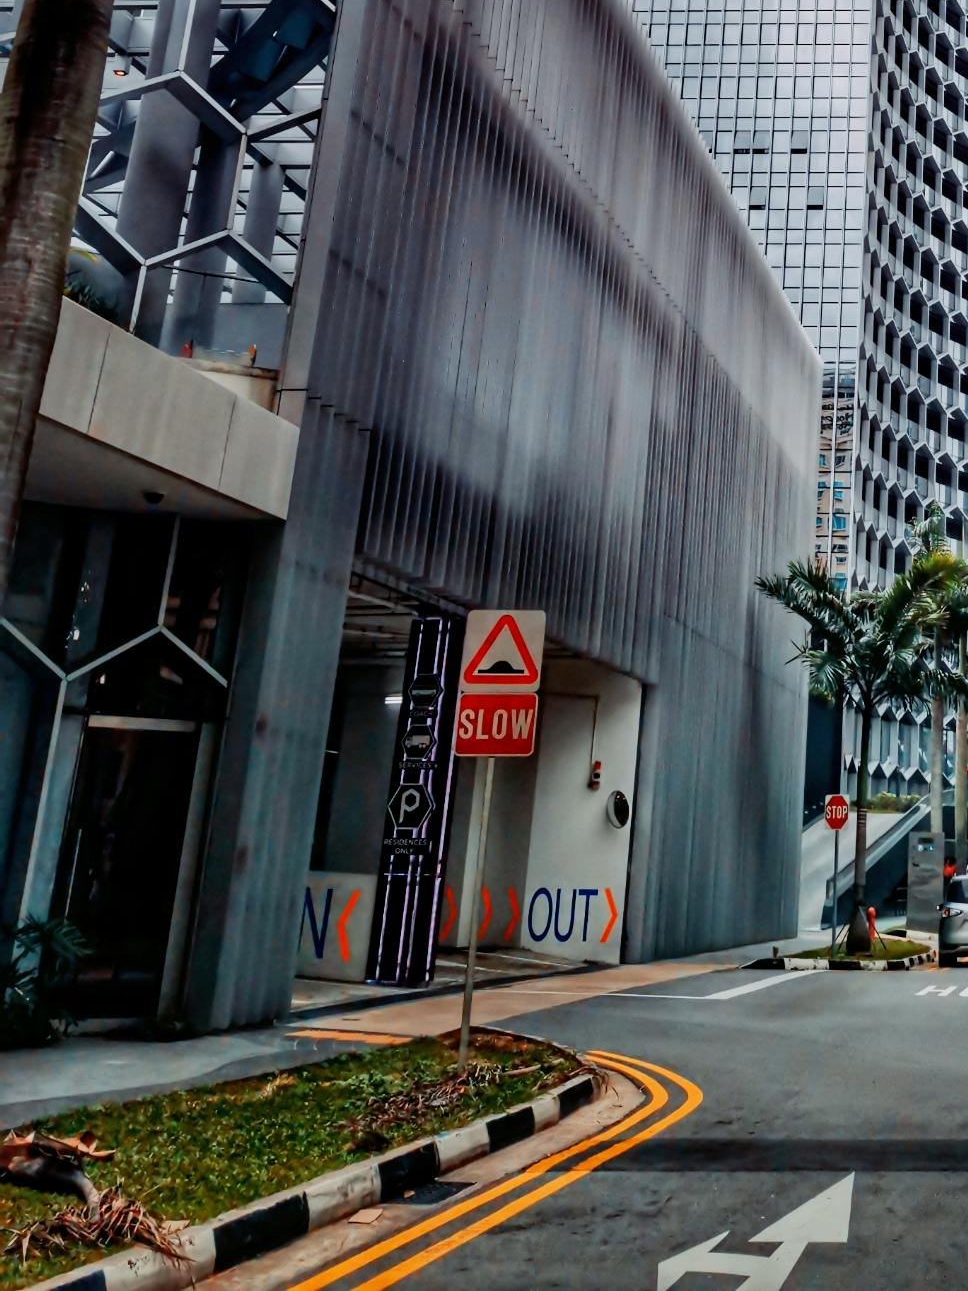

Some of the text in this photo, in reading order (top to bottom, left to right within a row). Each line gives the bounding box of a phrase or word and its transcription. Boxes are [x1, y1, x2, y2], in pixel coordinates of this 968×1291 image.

[459, 709, 534, 741] SLOW
[398, 761, 432, 769] SERVICES
[826, 805, 848, 819] STOP
[383, 838, 427, 846] RESIDENCES
[395, 847, 413, 855] ONLY
[528, 887, 598, 943] OUT
